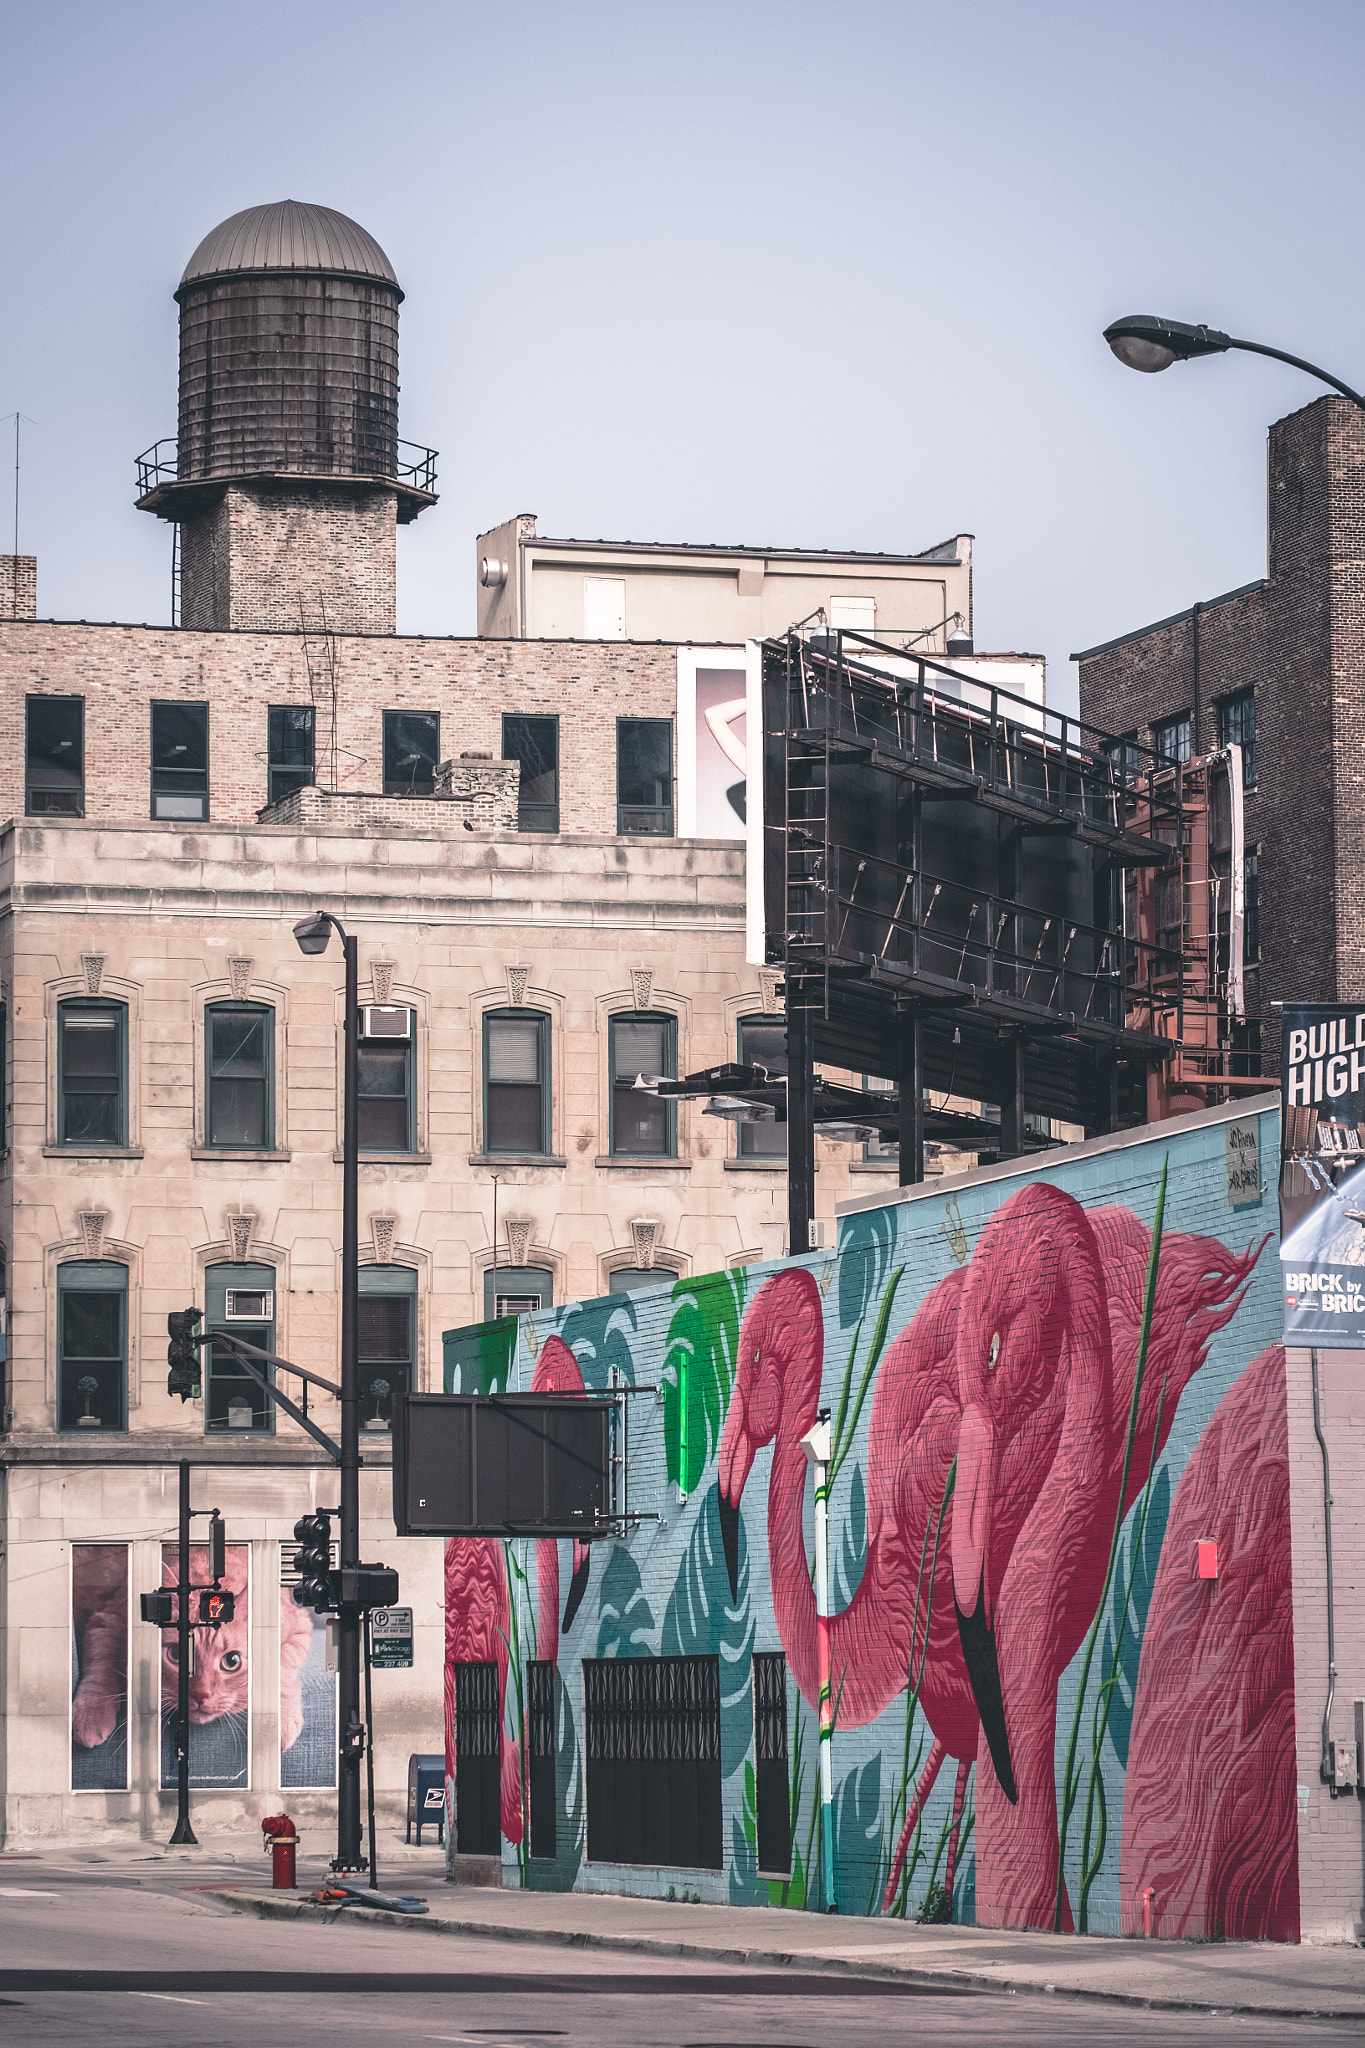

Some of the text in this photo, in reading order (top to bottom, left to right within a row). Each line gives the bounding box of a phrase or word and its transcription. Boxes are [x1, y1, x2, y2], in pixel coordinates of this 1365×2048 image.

[1286, 1273, 1362, 1295] BRICK by
[1322, 1294, 1365, 1314] BRIC
[378, 1614, 386, 1624] P
